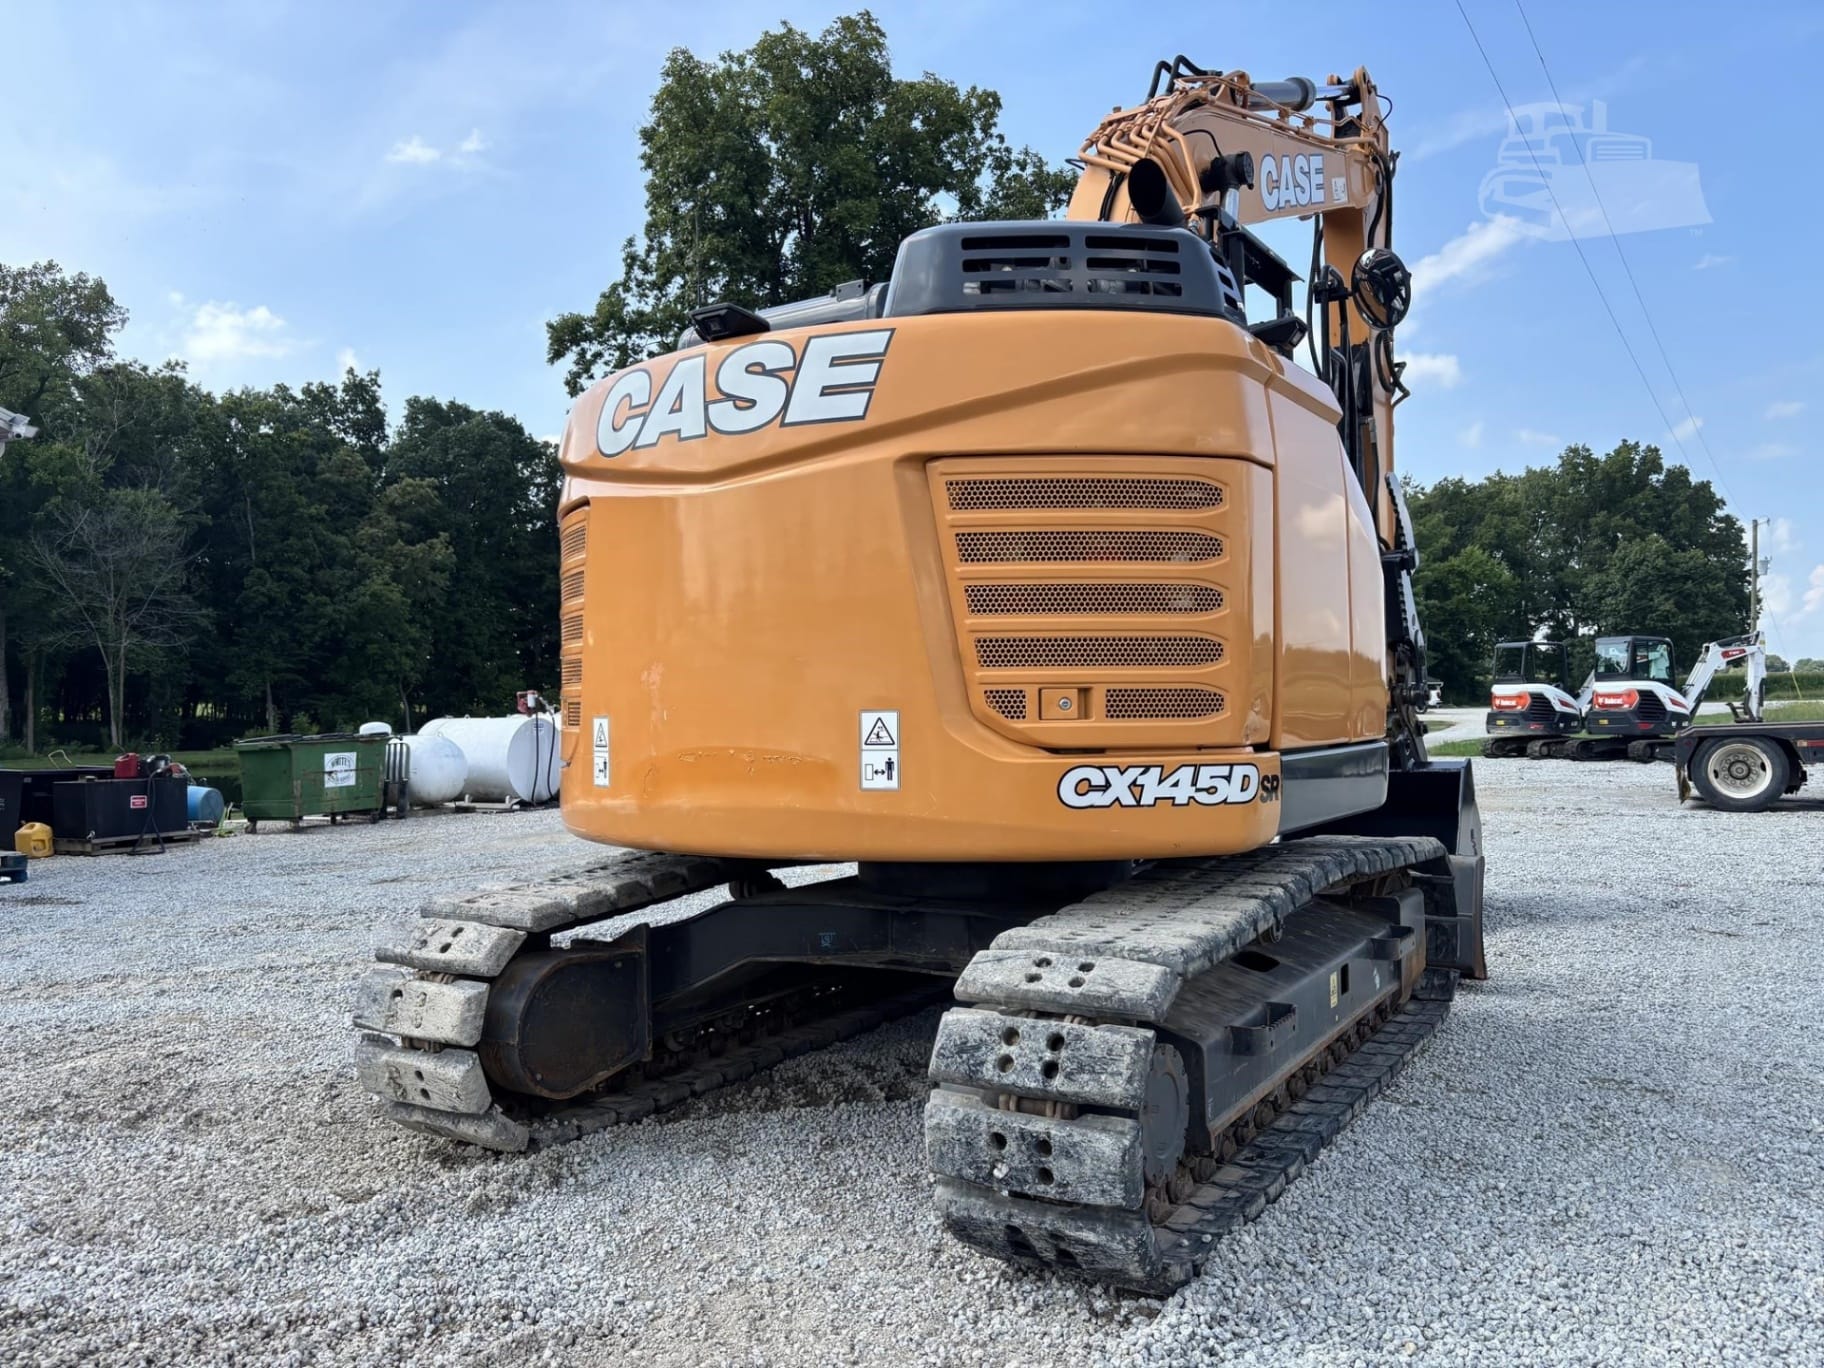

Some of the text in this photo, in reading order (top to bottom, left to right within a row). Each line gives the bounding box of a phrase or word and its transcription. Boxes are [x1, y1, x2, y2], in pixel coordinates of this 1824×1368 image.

[1260, 153, 1325, 212] CASE
[597, 328, 896, 458] CASE
[1057, 763, 1280, 810] CX145D SR
